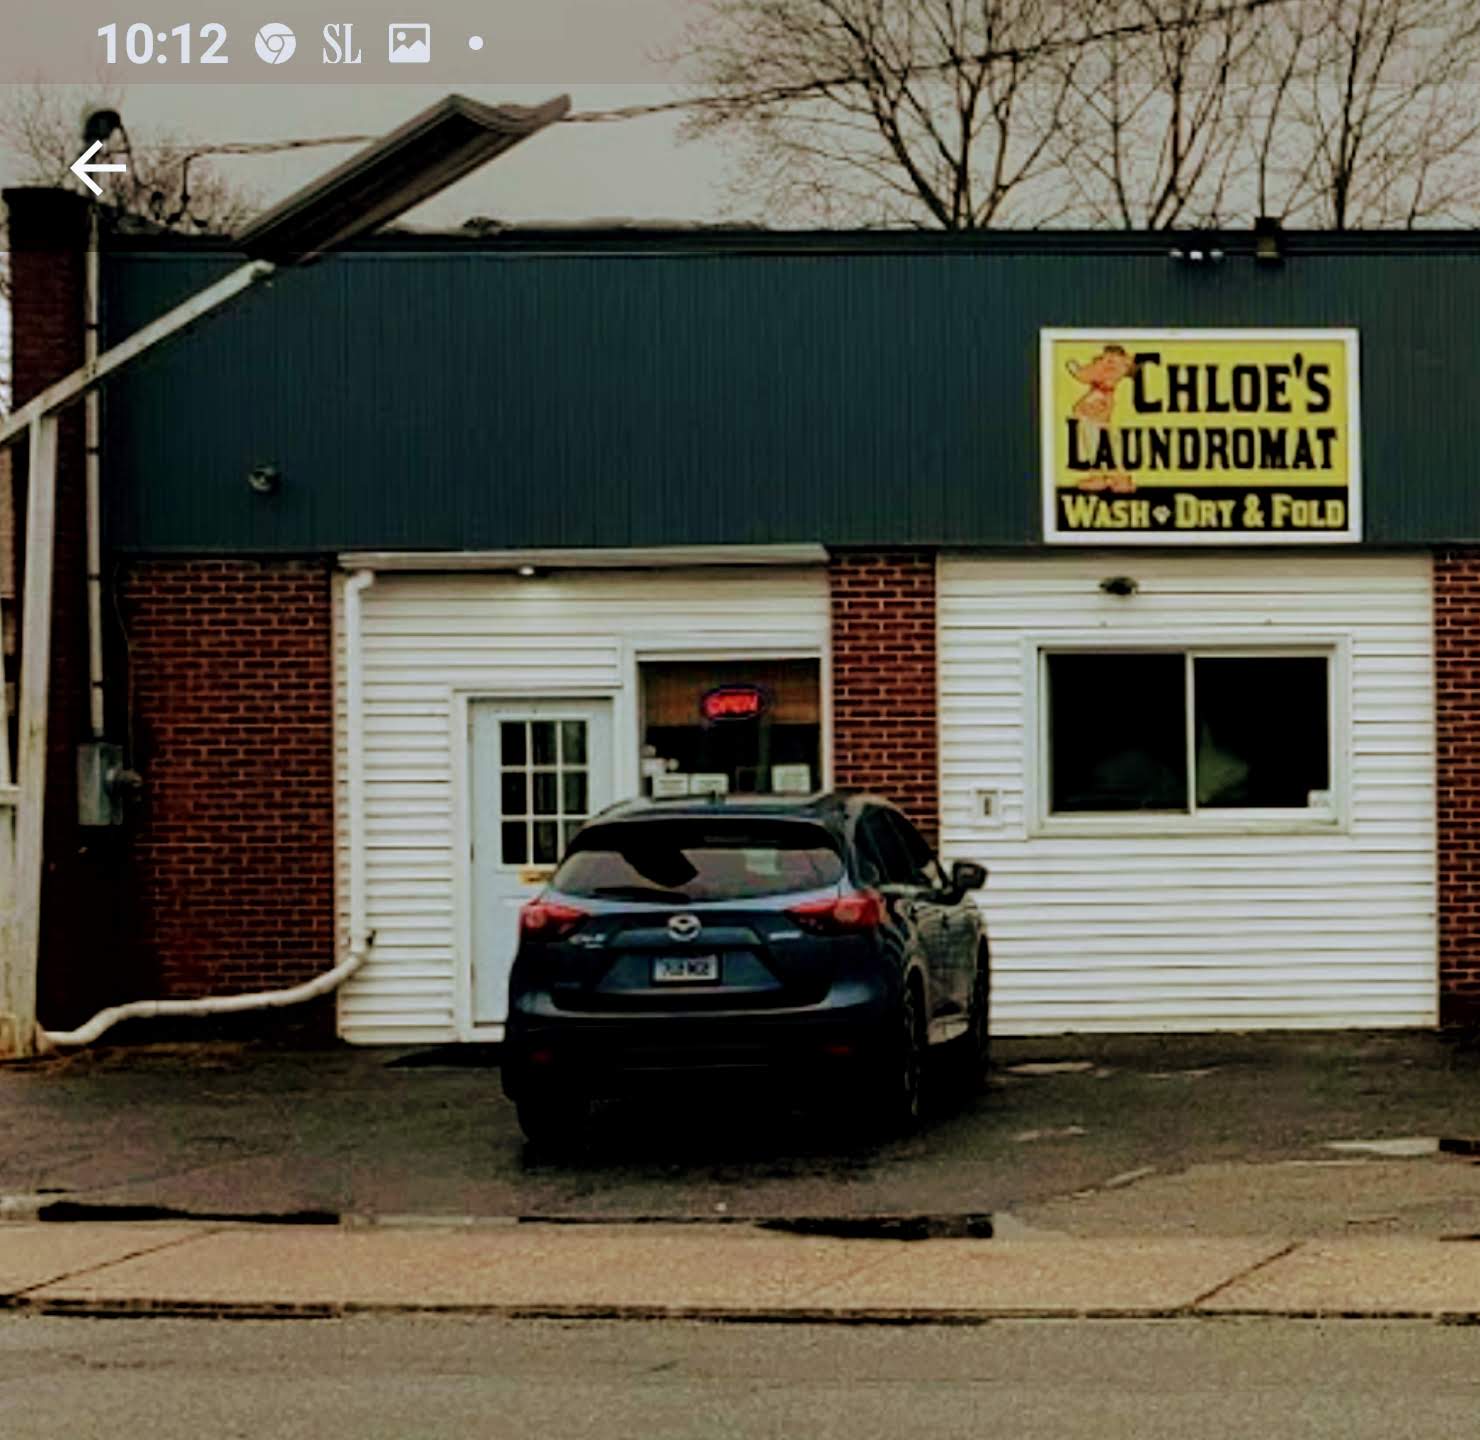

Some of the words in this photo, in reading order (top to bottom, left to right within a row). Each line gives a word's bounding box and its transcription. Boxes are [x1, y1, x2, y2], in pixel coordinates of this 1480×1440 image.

[1132, 352, 1332, 414] CHLOE'S
[1066, 417, 1338, 471] LAUNDROMAT
[1061, 493, 1150, 529] WASH
[1173, 493, 1237, 529] DRY
[1242, 493, 1265, 529] &
[1270, 493, 1345, 529] FOLD
[704, 693, 759, 717] OPEN
